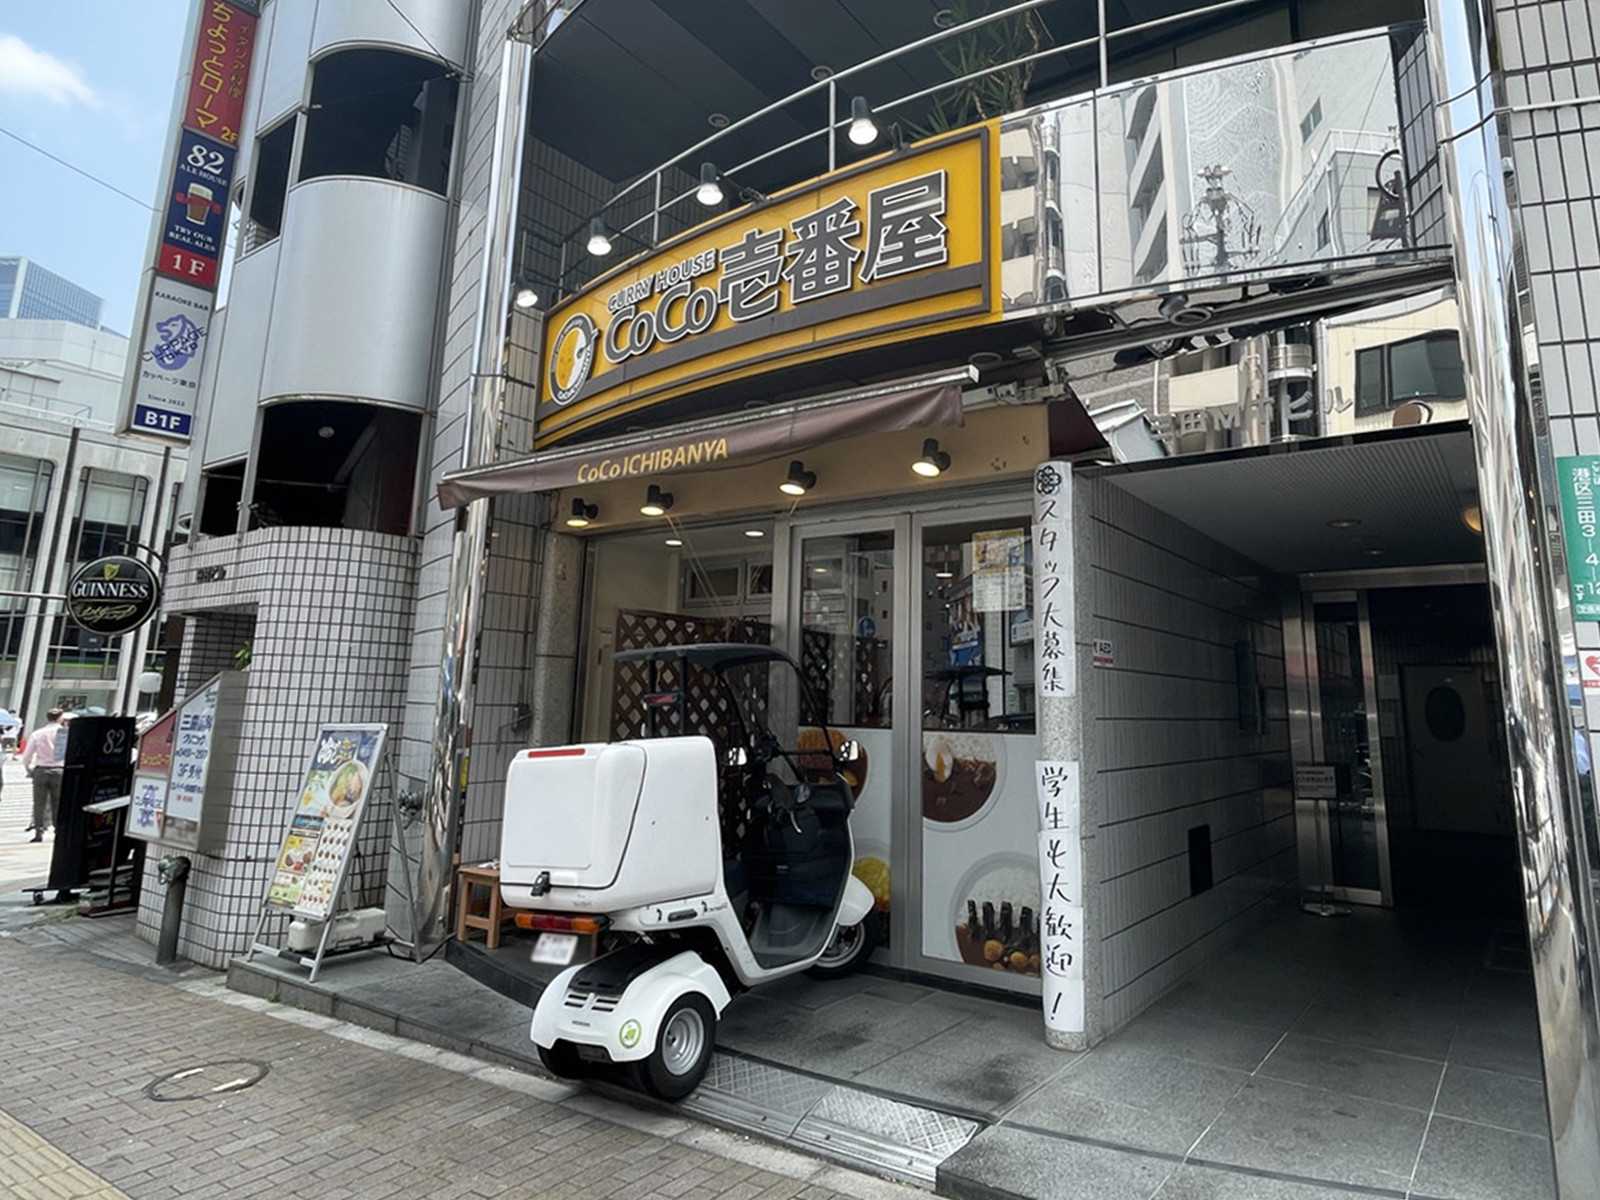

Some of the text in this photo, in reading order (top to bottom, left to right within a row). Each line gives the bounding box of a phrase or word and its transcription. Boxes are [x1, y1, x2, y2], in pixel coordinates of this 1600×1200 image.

[221, 126, 238, 142] 2F
[187, 144, 225, 175] 82
[179, 163, 228, 187] ALE HOUSE
[169, 231, 216, 252] REAL ALES
[174, 224, 213, 243] TRY OUR
[606, 247, 717, 314] CURRY HOUSE
[155, 291, 209, 311] KARAOKE BAR
[144, 410, 181, 429] B1F
[72, 581, 149, 598] GUINNESS
[1039, 499, 1065, 691] スタッフ大募集
[102, 729, 126, 754] 82
